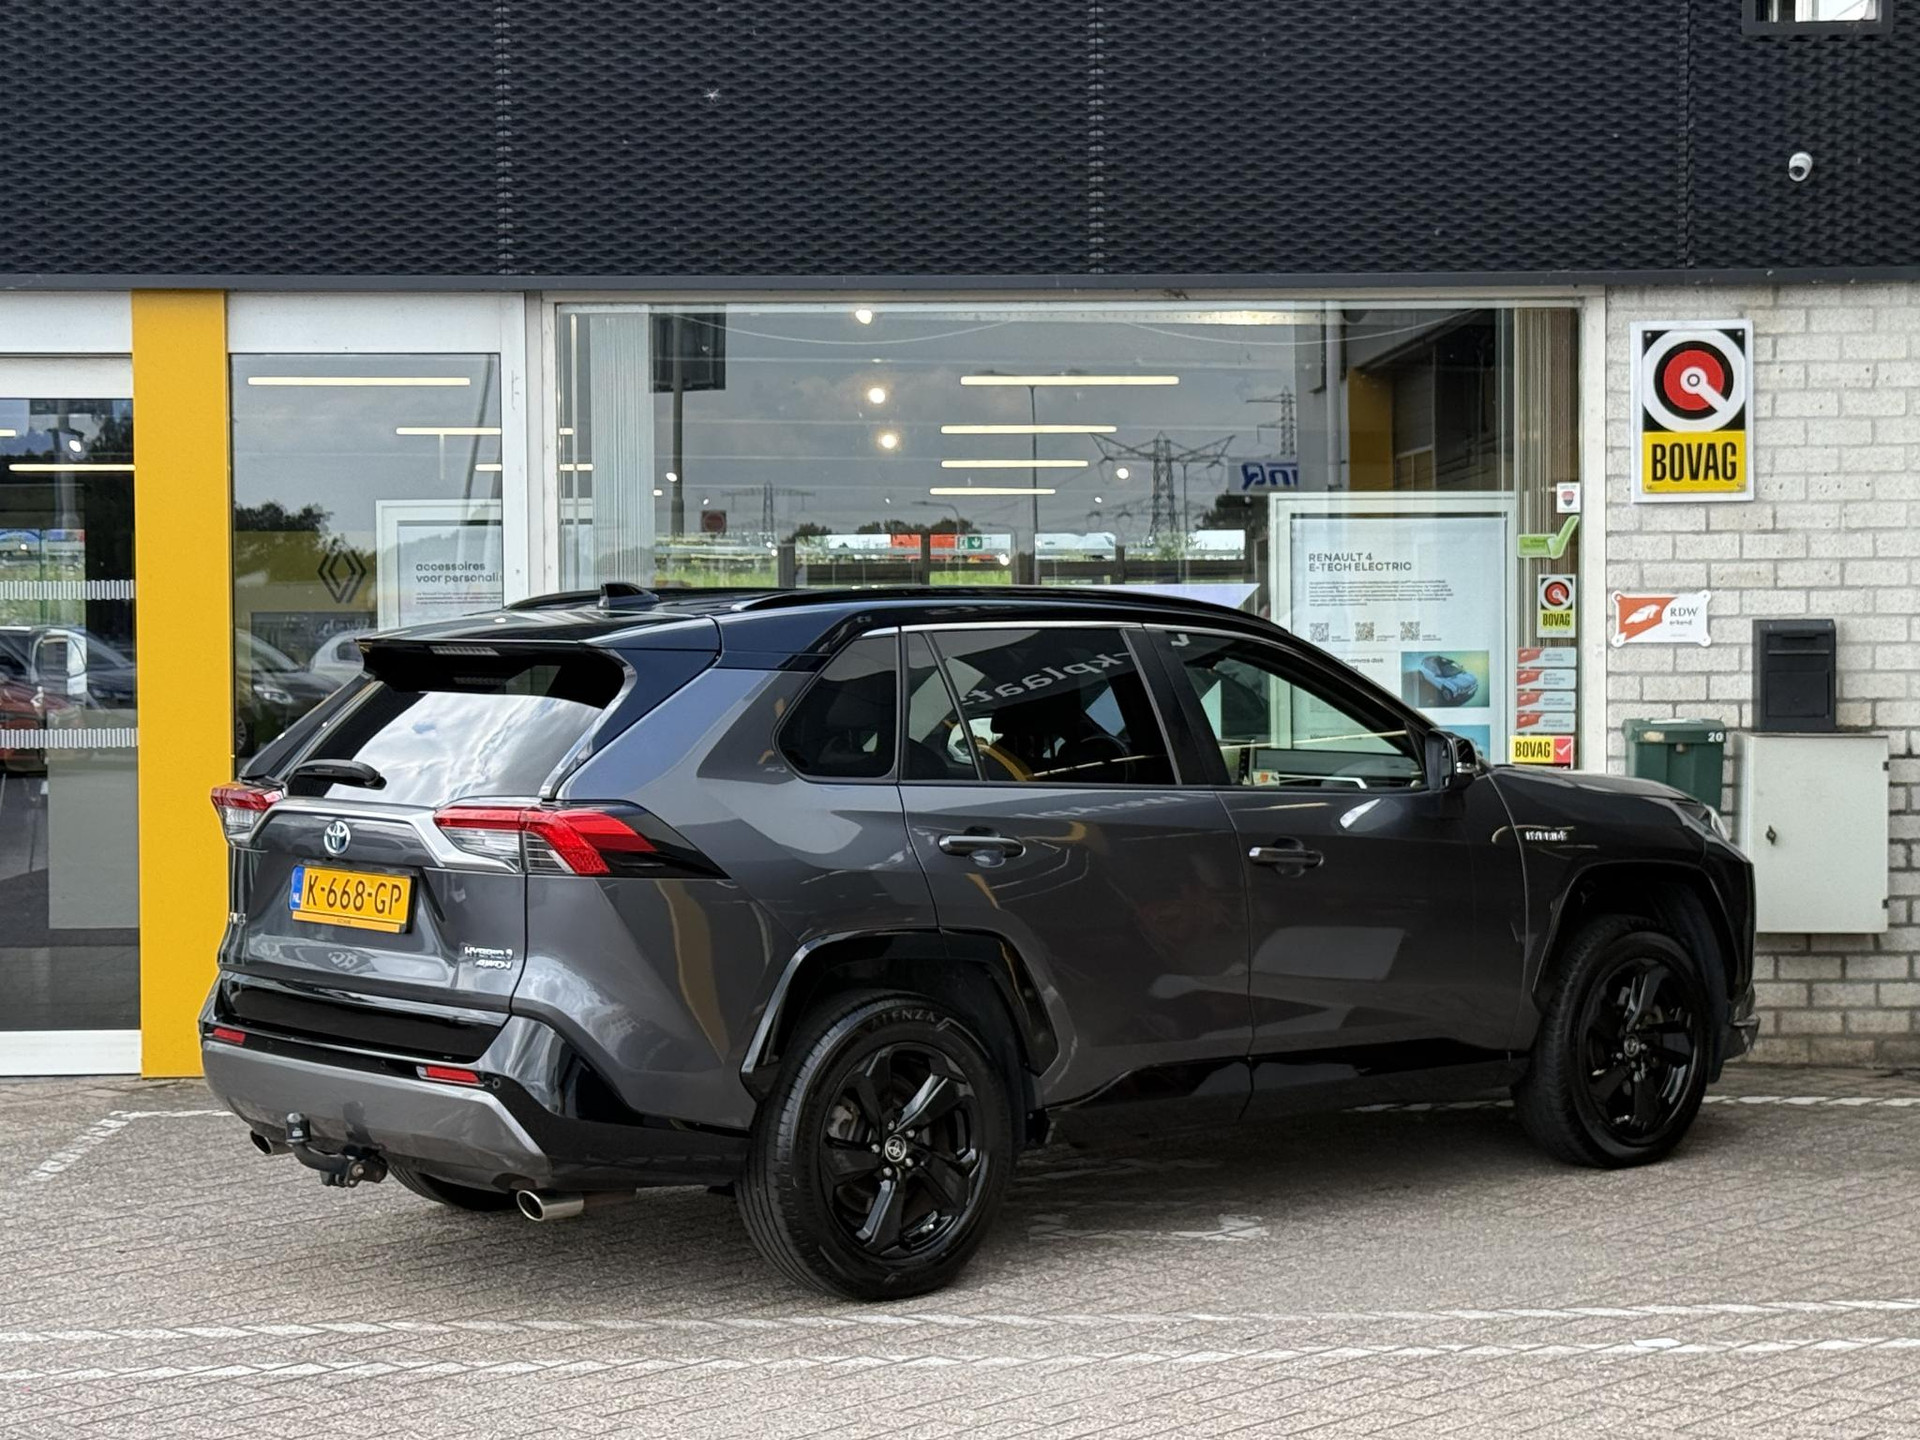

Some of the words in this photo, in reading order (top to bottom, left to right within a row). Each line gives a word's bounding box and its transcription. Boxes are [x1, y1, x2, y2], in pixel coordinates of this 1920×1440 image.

[1651, 441, 1738, 482] BOVAG
[1308, 553, 1363, 562] RENAULT
[1365, 552, 1373, 561] 4
[415, 561, 486, 571] accessoires
[1308, 562, 1351, 572] E-TECH
[1354, 562, 1412, 571] ELECTRIC
[416, 574, 441, 583] voor
[444, 572, 502, 584] personali
[1670, 606, 1699, 617] RDW
[1542, 612, 1571, 627] BOVAG
[1707, 731, 1725, 743] 20
[1514, 740, 1552, 759] BOVAG
[306, 874, 403, 915] K-668-GP
